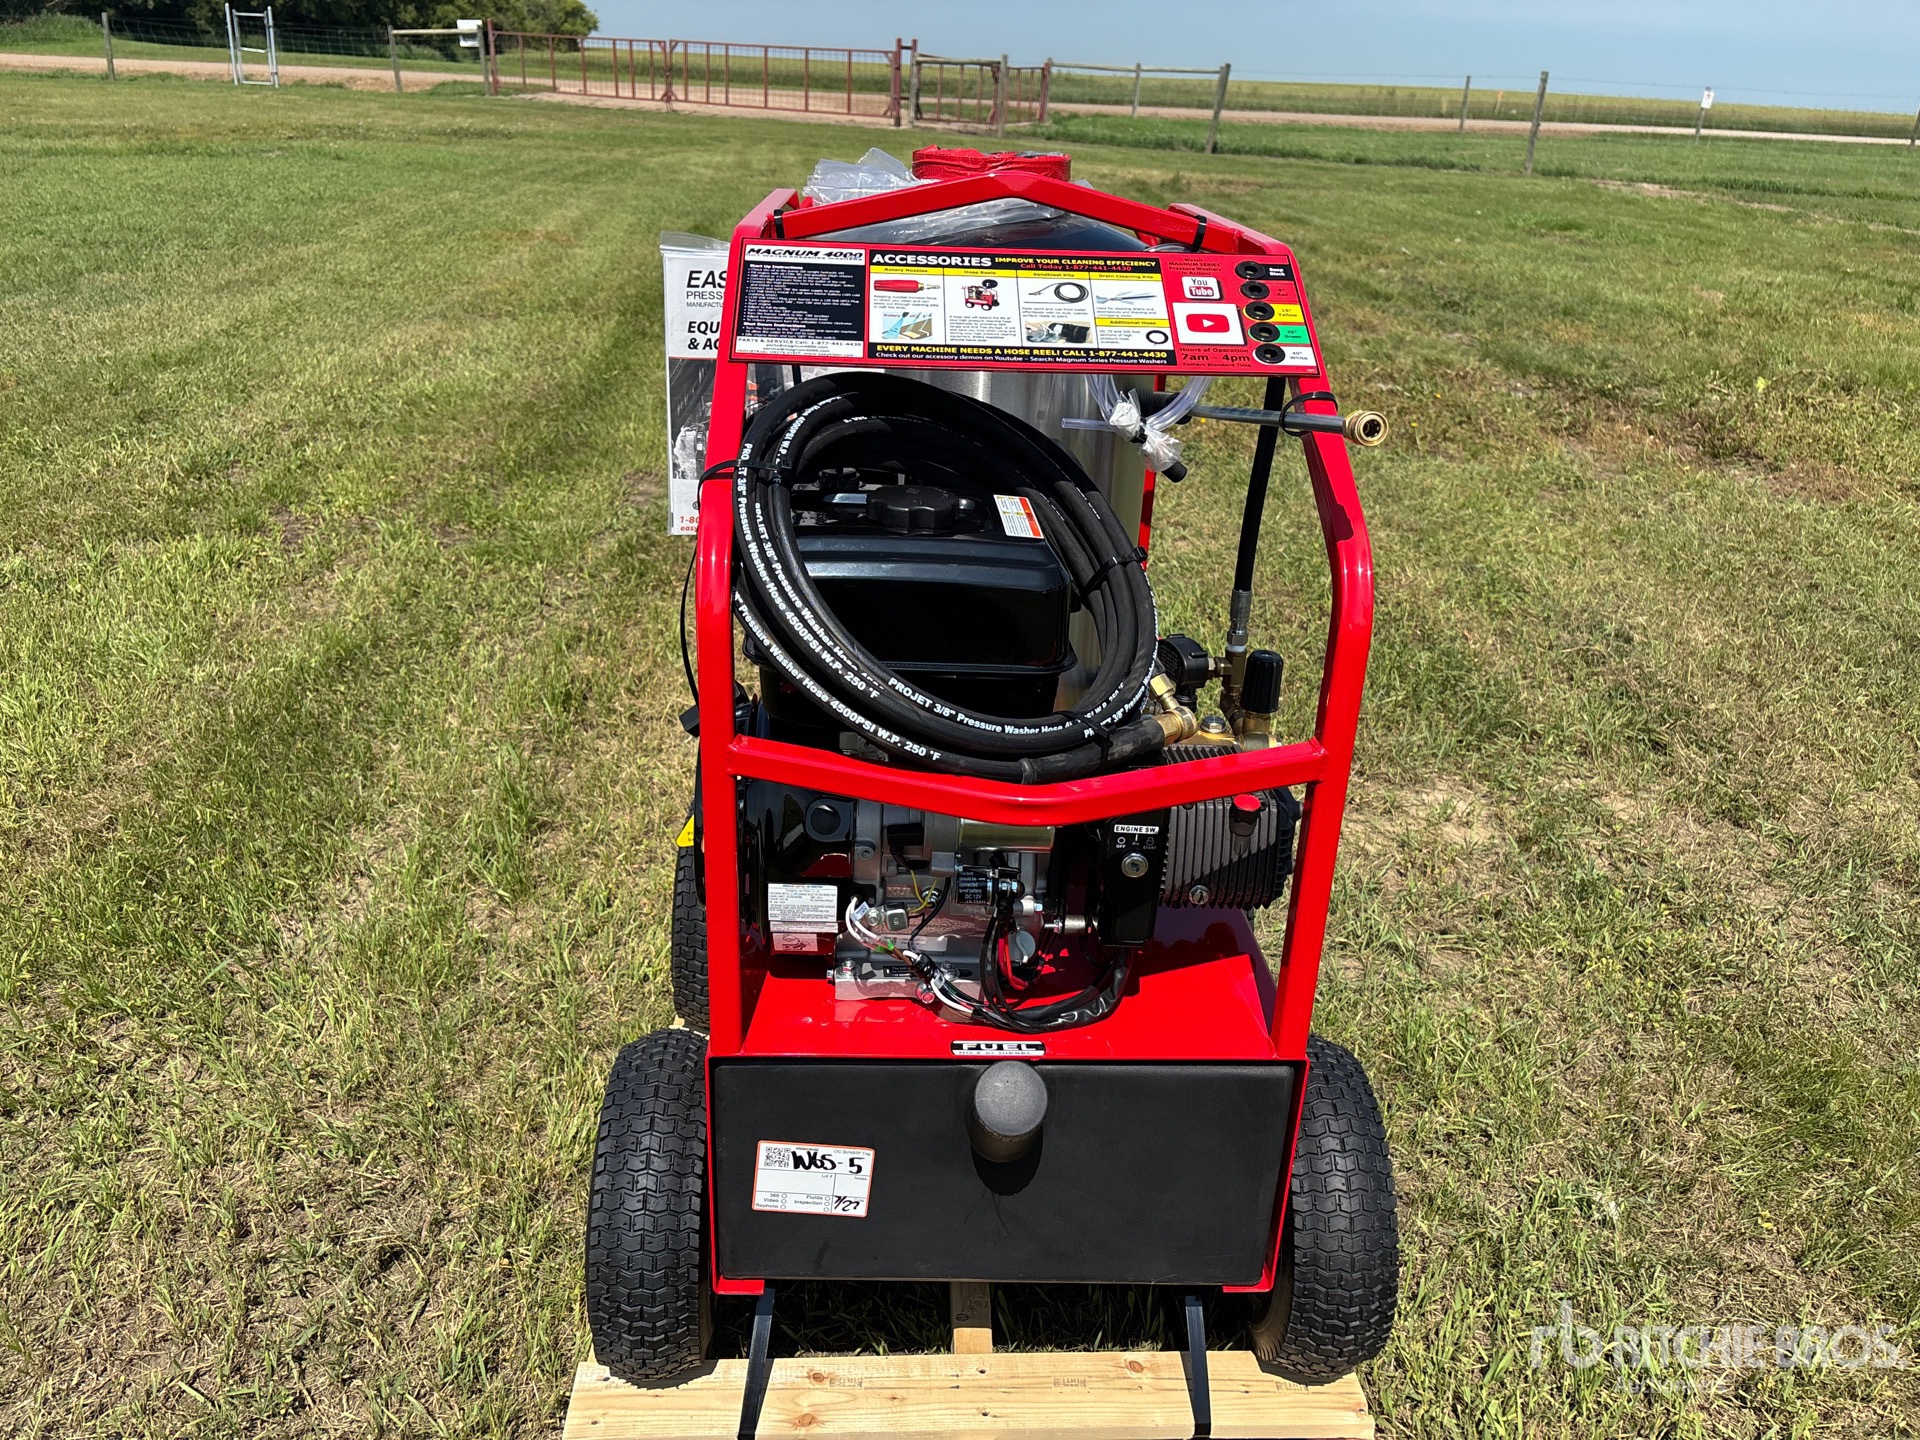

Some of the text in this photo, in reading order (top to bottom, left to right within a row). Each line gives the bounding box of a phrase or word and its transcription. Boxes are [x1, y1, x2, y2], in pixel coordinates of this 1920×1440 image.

[748, 248, 820, 257] MAGNUM
[872, 254, 992, 266] ACCESSORIES
[686, 290, 723, 300] PRESS
[1190, 287, 1213, 296] Tube
[687, 321, 720, 335] EQU
[687, 337, 700, 350] &
[1222, 354, 1250, 362] 4pm
[738, 497, 752, 541] Pressure
[748, 541, 771, 582] Washer
[766, 582, 786, 611] Hose
[785, 611, 823, 653] 4500PSI
[821, 650, 843, 674] W.P.
[844, 671, 866, 691] 250
[868, 686, 880, 698] °F
[763, 541, 778, 561] 3/8"
[772, 562, 802, 608] Pressure
[801, 607, 833, 647] Washer
[738, 604, 942, 761] Pressure Washer Hose 4500PSI W.P. 250 °F
[1124, 685, 1145, 712] Pressure
[887, 676, 933, 708] PROJET
[933, 702, 956, 717] 3/8"
[956, 712, 1002, 733] Pressure
[1004, 724, 1040, 735] Washer
[962, 1043, 1036, 1051] FUEL
